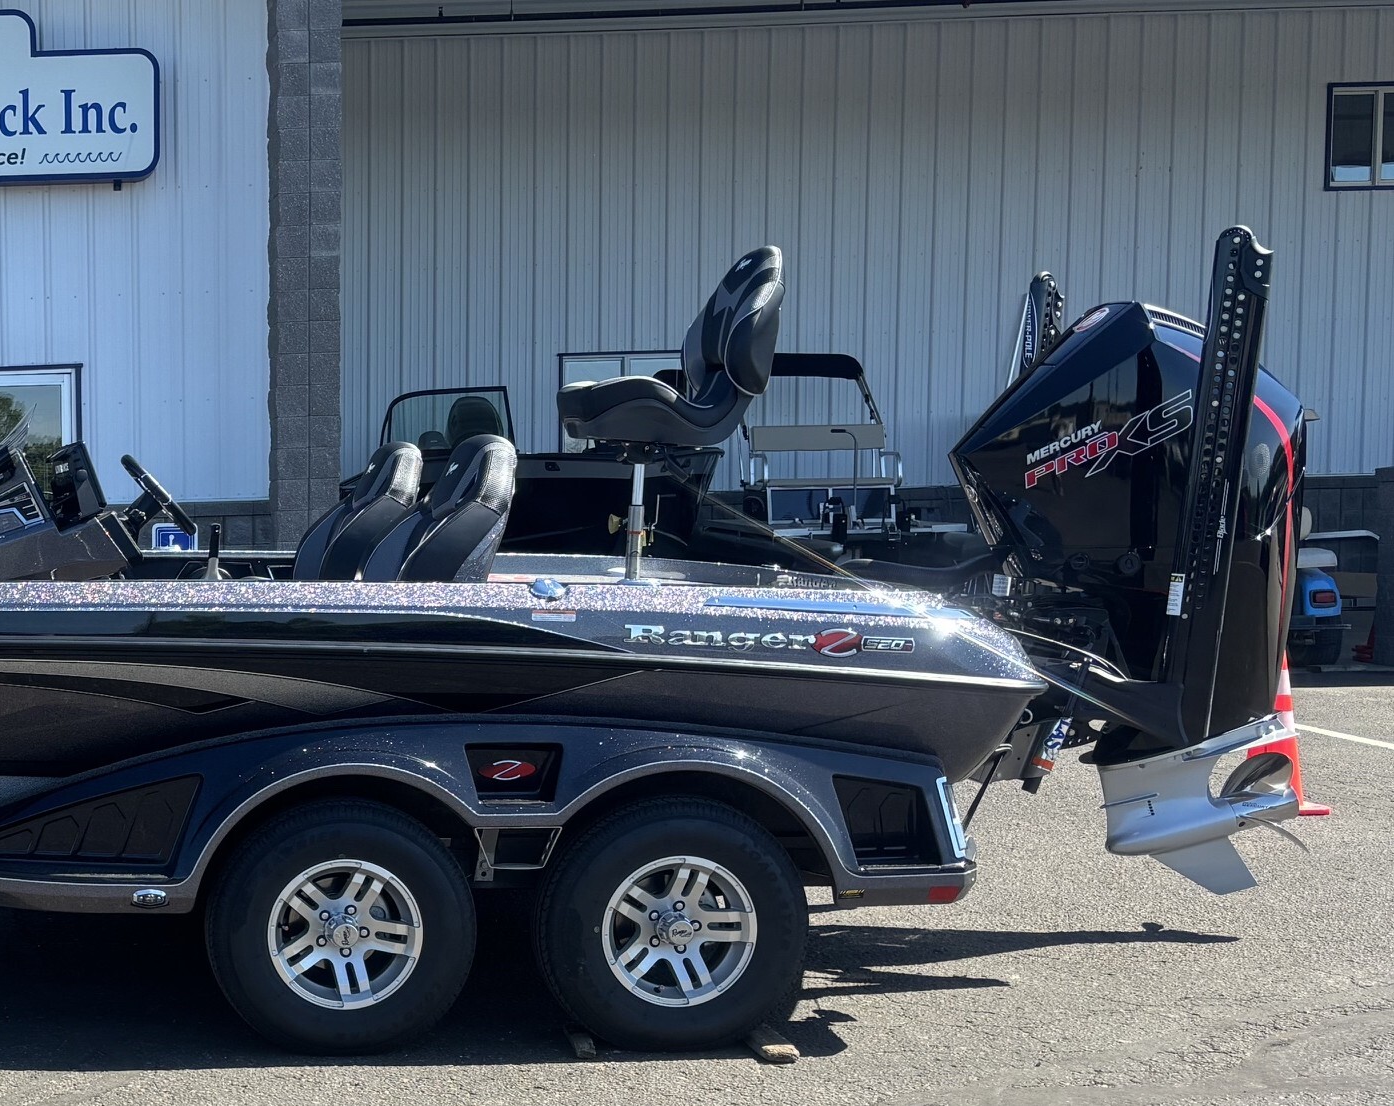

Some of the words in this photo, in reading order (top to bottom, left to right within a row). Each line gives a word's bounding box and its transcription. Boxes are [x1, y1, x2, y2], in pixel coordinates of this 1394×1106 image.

[60, 89, 138, 134] Inc.
[1025, 431, 1119, 489] PRO
[1026, 420, 1102, 466] MERCURY
[624, 624, 816, 651] Ranger
